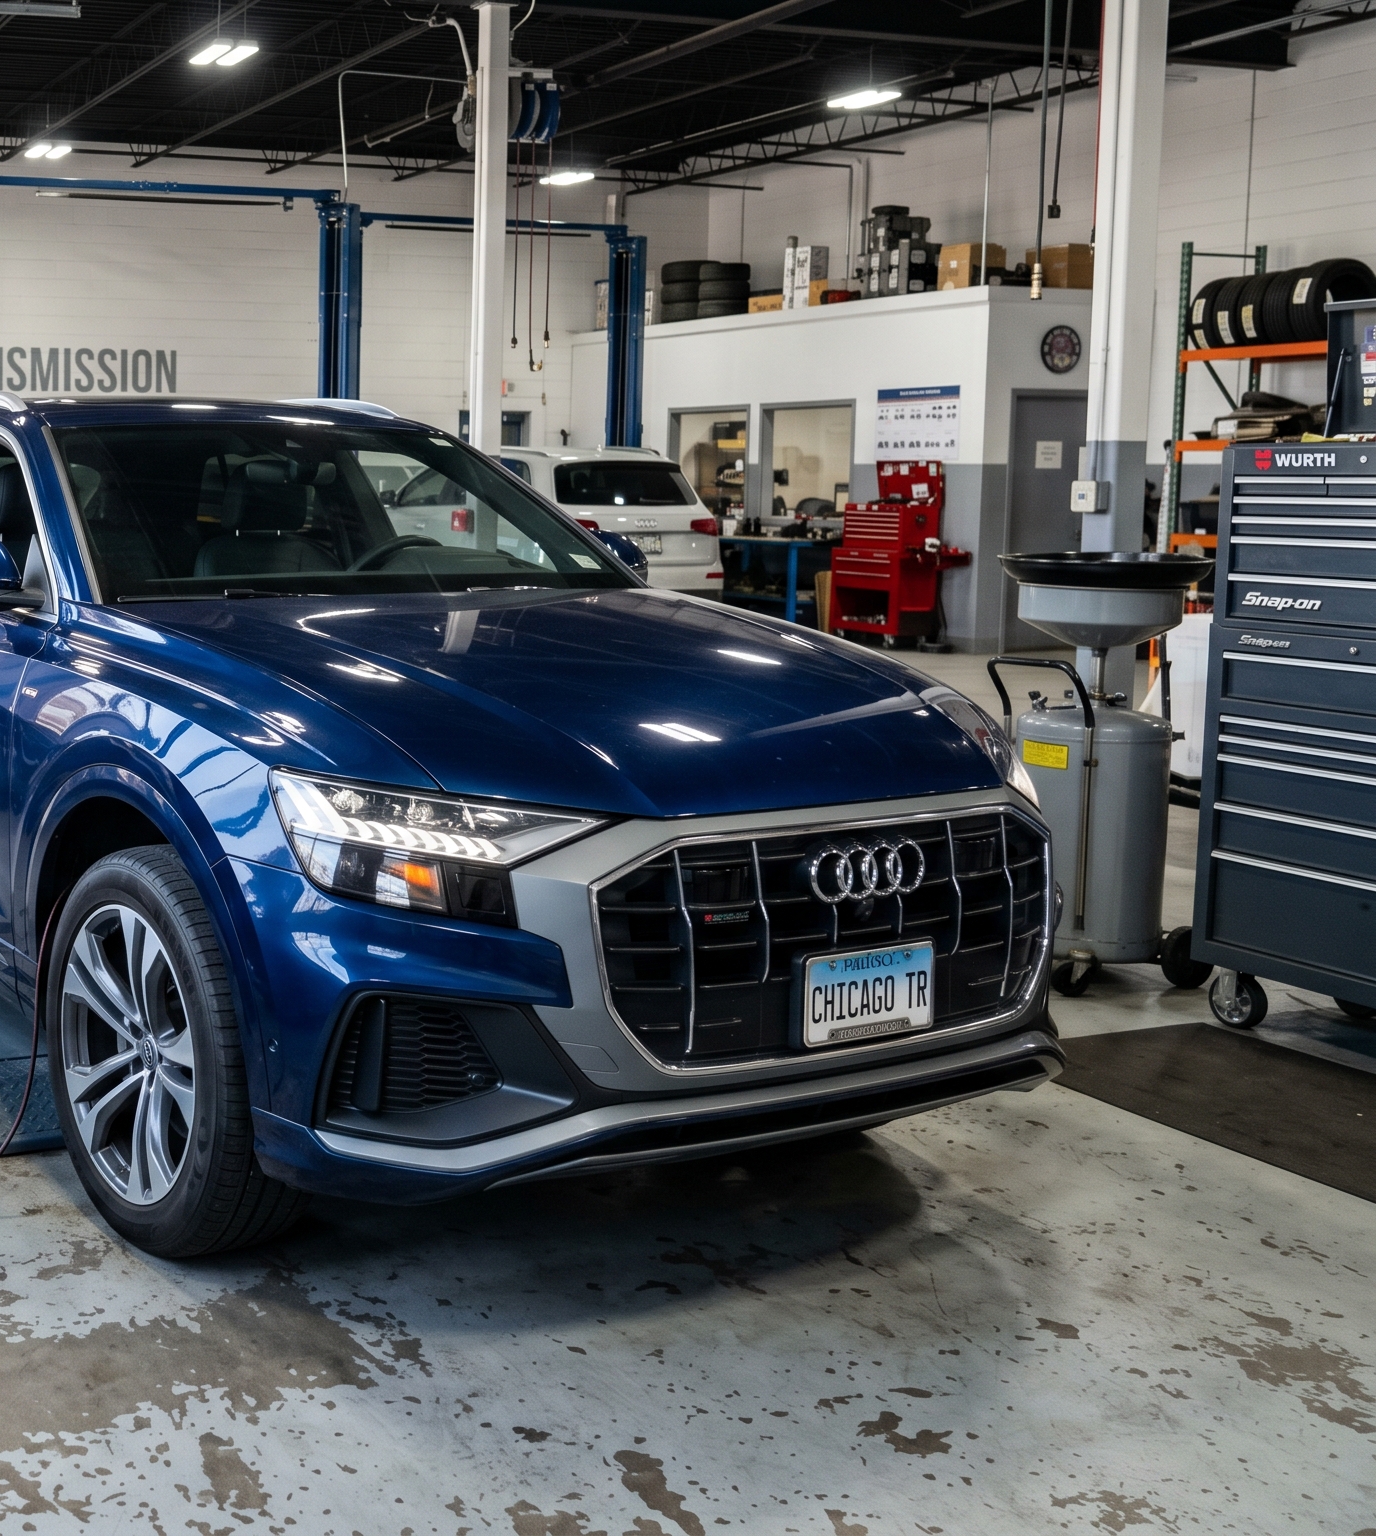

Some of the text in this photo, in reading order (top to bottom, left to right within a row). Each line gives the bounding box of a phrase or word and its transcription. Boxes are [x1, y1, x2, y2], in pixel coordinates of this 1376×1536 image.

[1275, 453, 1336, 467] WURTH
[1241, 591, 1322, 611] Snap-on
[811, 970, 927, 1024] CHICAGO TR
